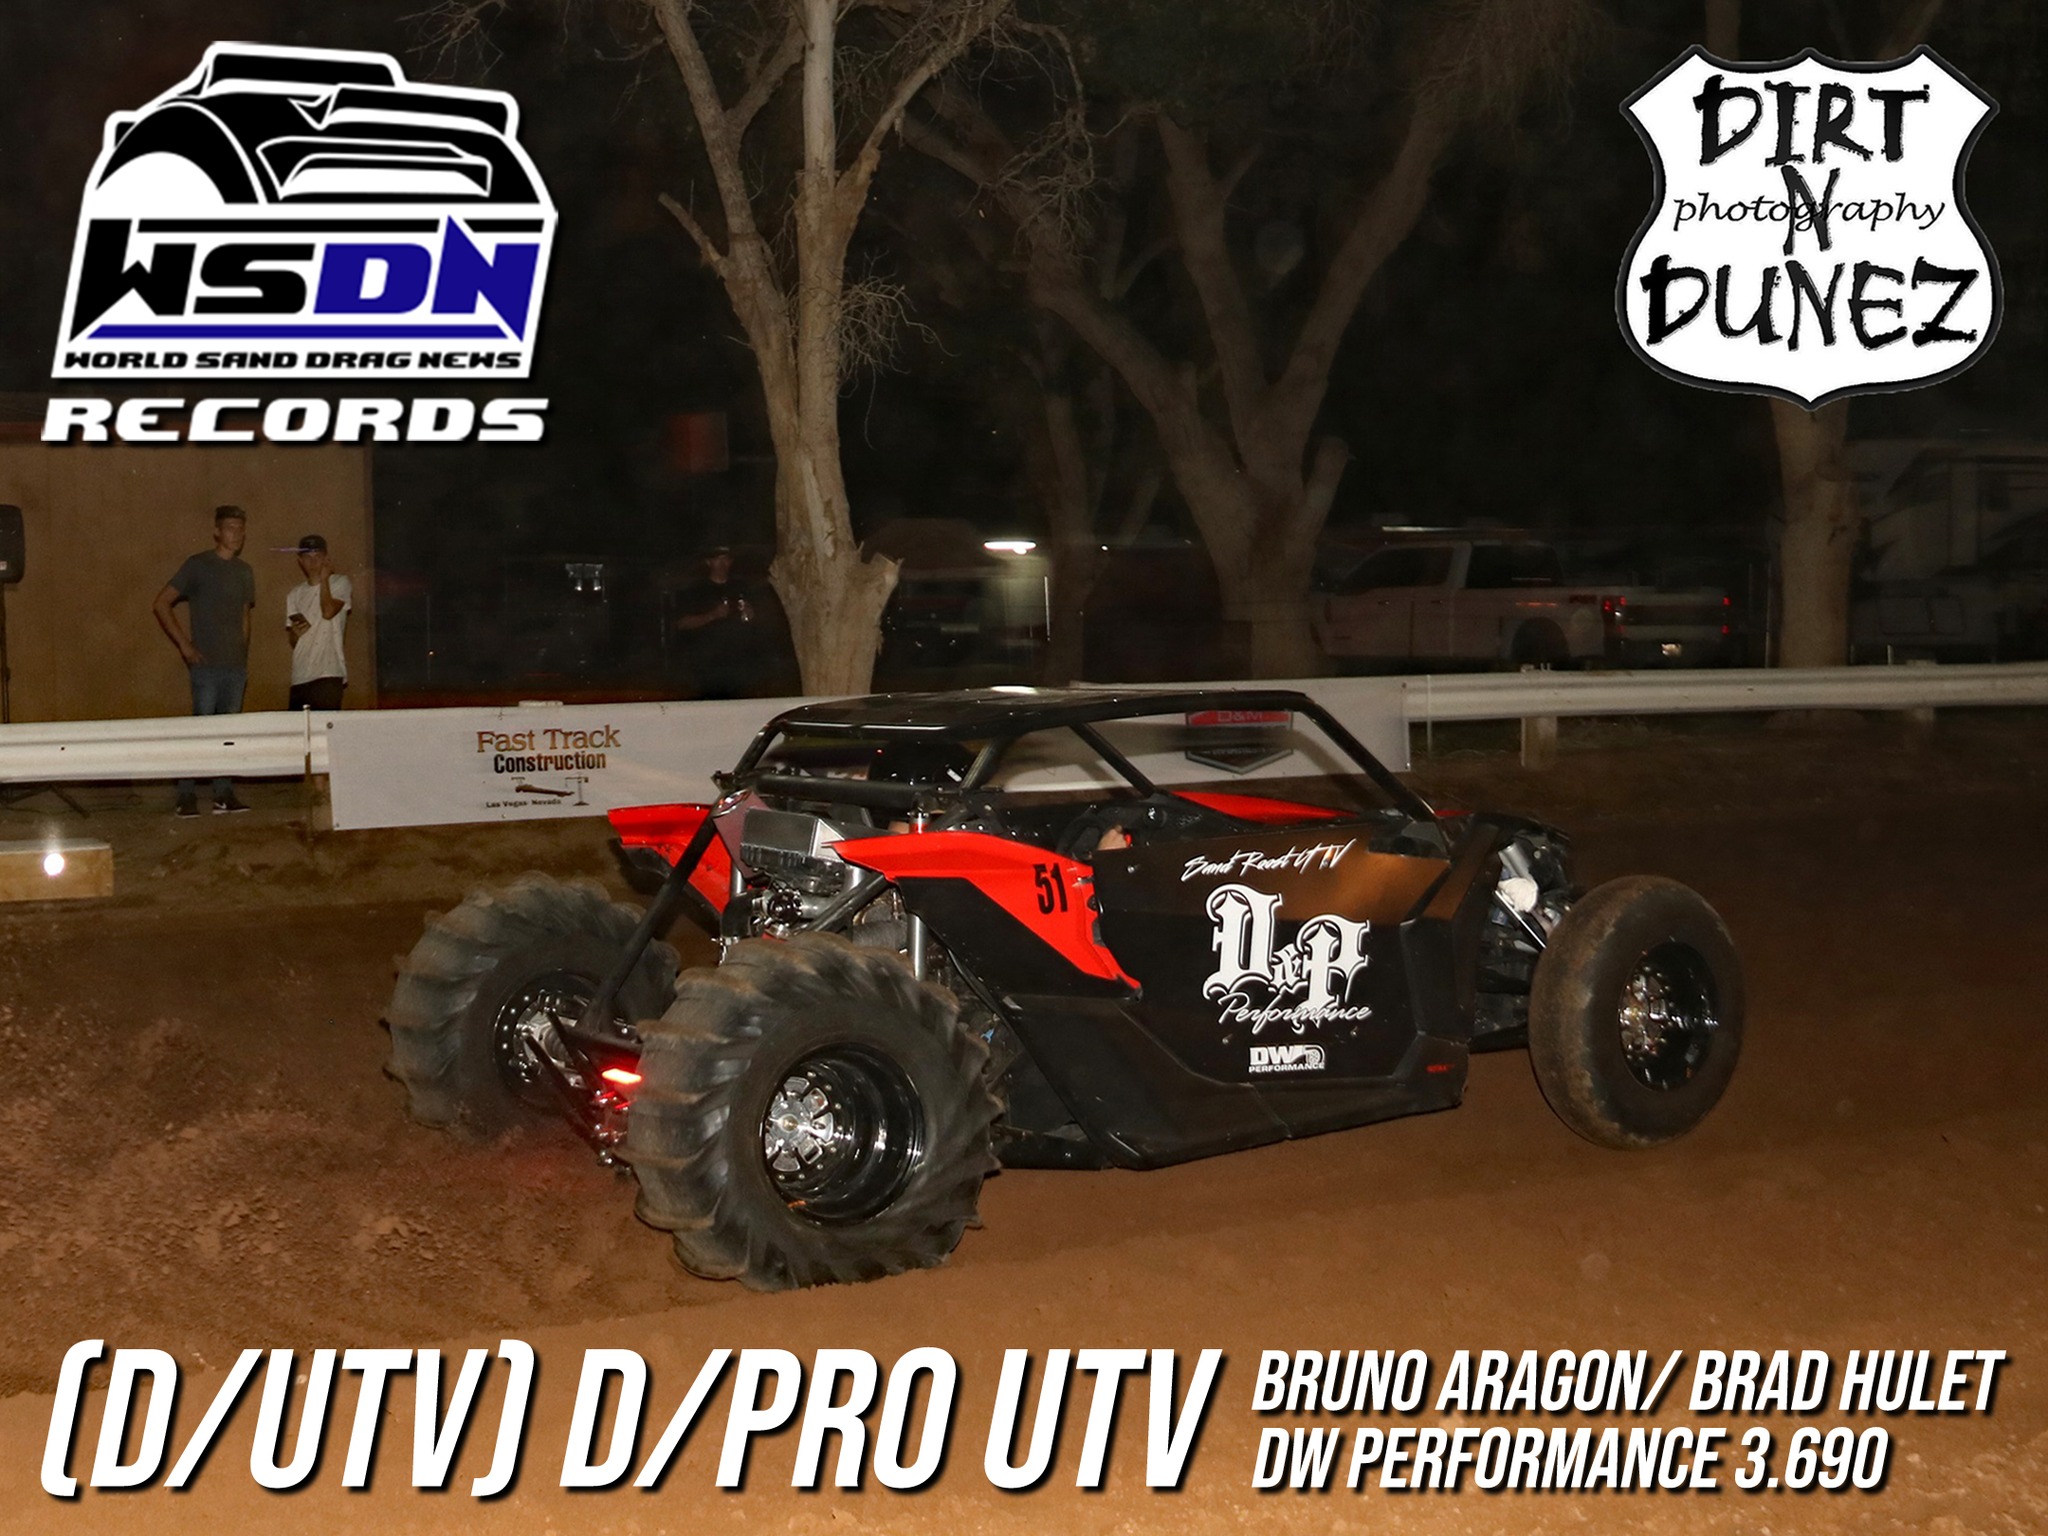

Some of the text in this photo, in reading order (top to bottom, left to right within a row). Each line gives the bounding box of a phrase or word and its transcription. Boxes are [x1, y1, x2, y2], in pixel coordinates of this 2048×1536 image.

[476, 724, 621, 753] Fast Track
[494, 750, 607, 774] Construction
[1181, 850, 1240, 882] Sand
[1238, 846, 1299, 877] Roost
[1033, 863, 1068, 915] 51
[1217, 992, 1373, 1035] Performance
[1249, 1061, 1325, 1073] PERFORMANCE
